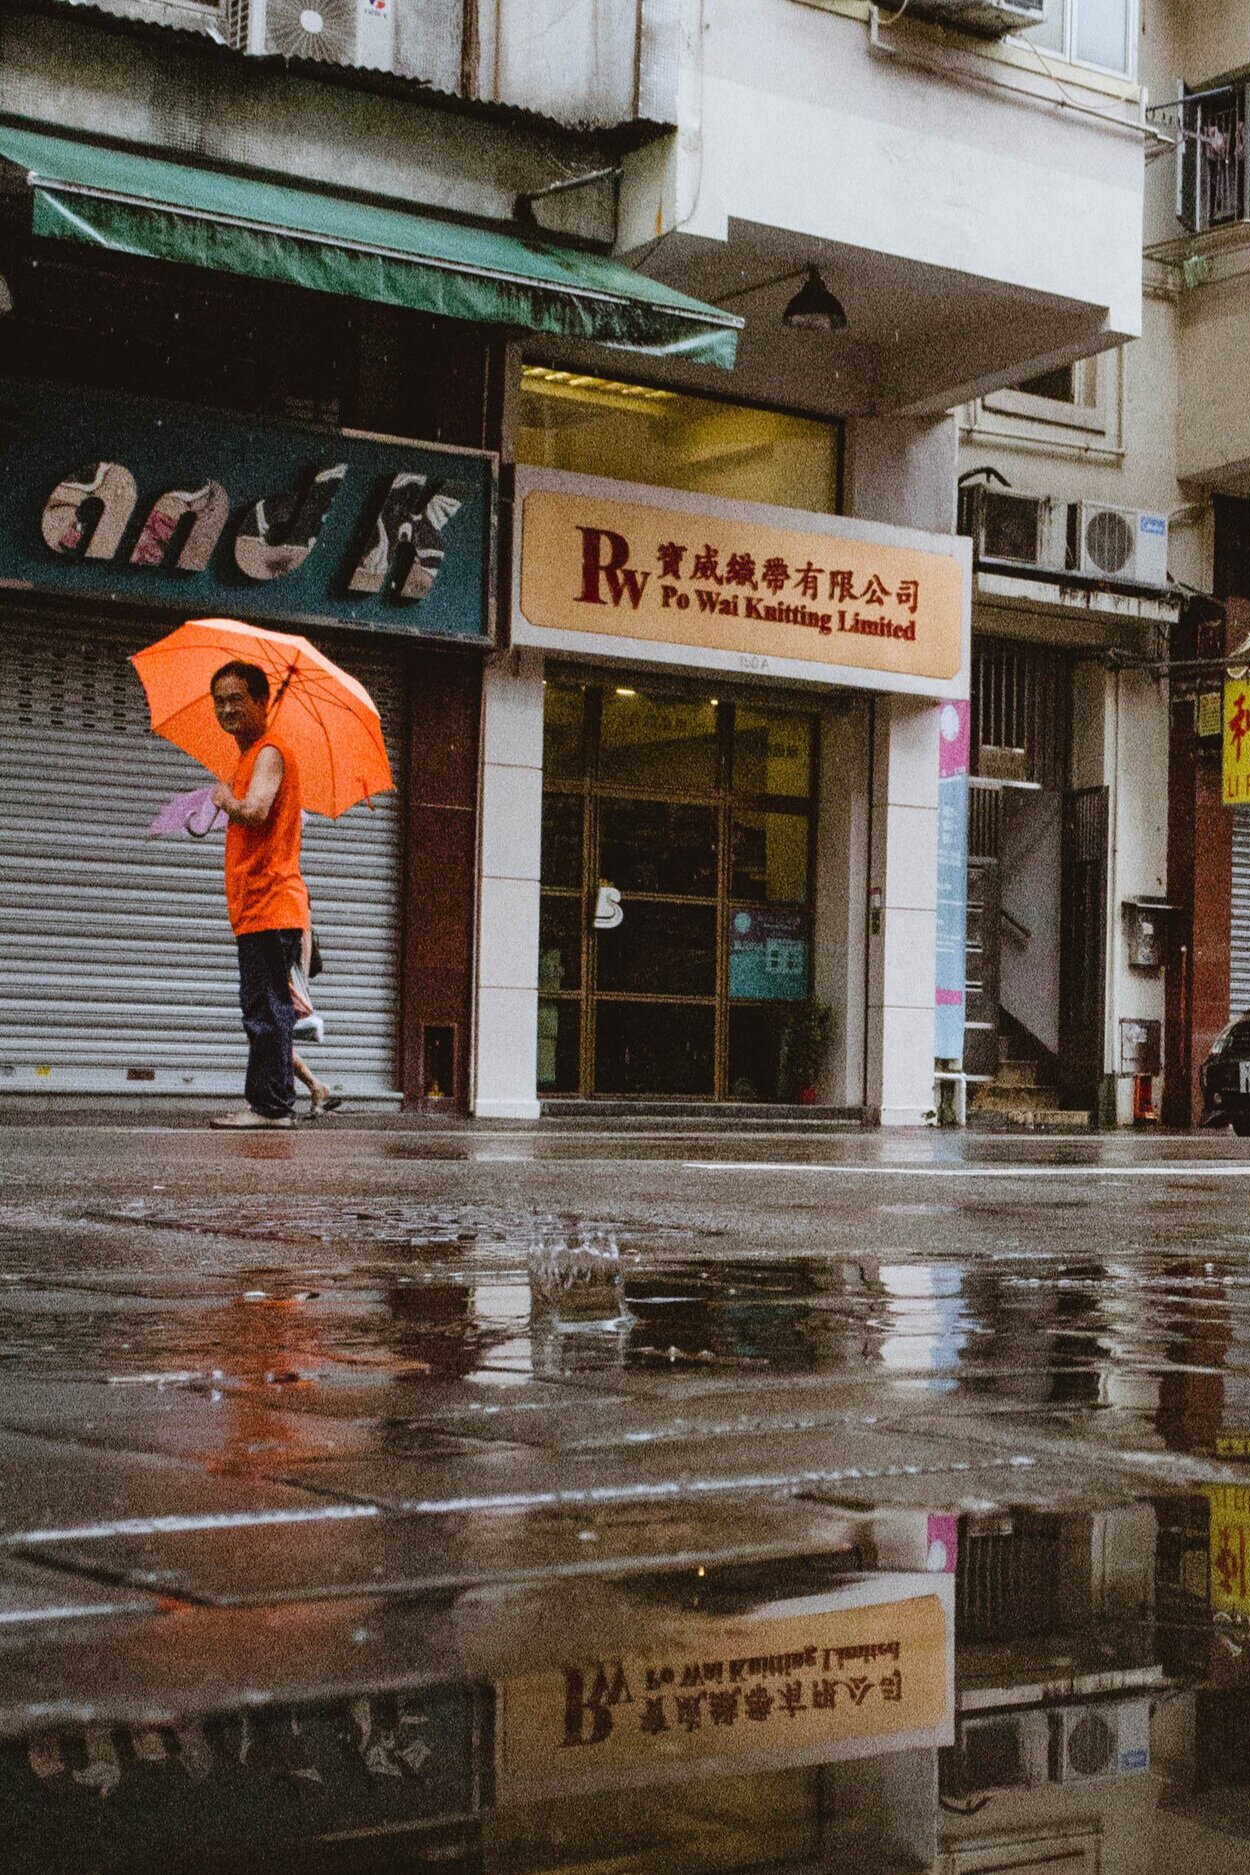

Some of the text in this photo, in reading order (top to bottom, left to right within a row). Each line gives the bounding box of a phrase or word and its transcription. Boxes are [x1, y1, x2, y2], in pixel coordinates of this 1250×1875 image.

[661, 584, 916, 641] Po Wai Knitting Limited
[1227, 776, 1242, 799] LI
